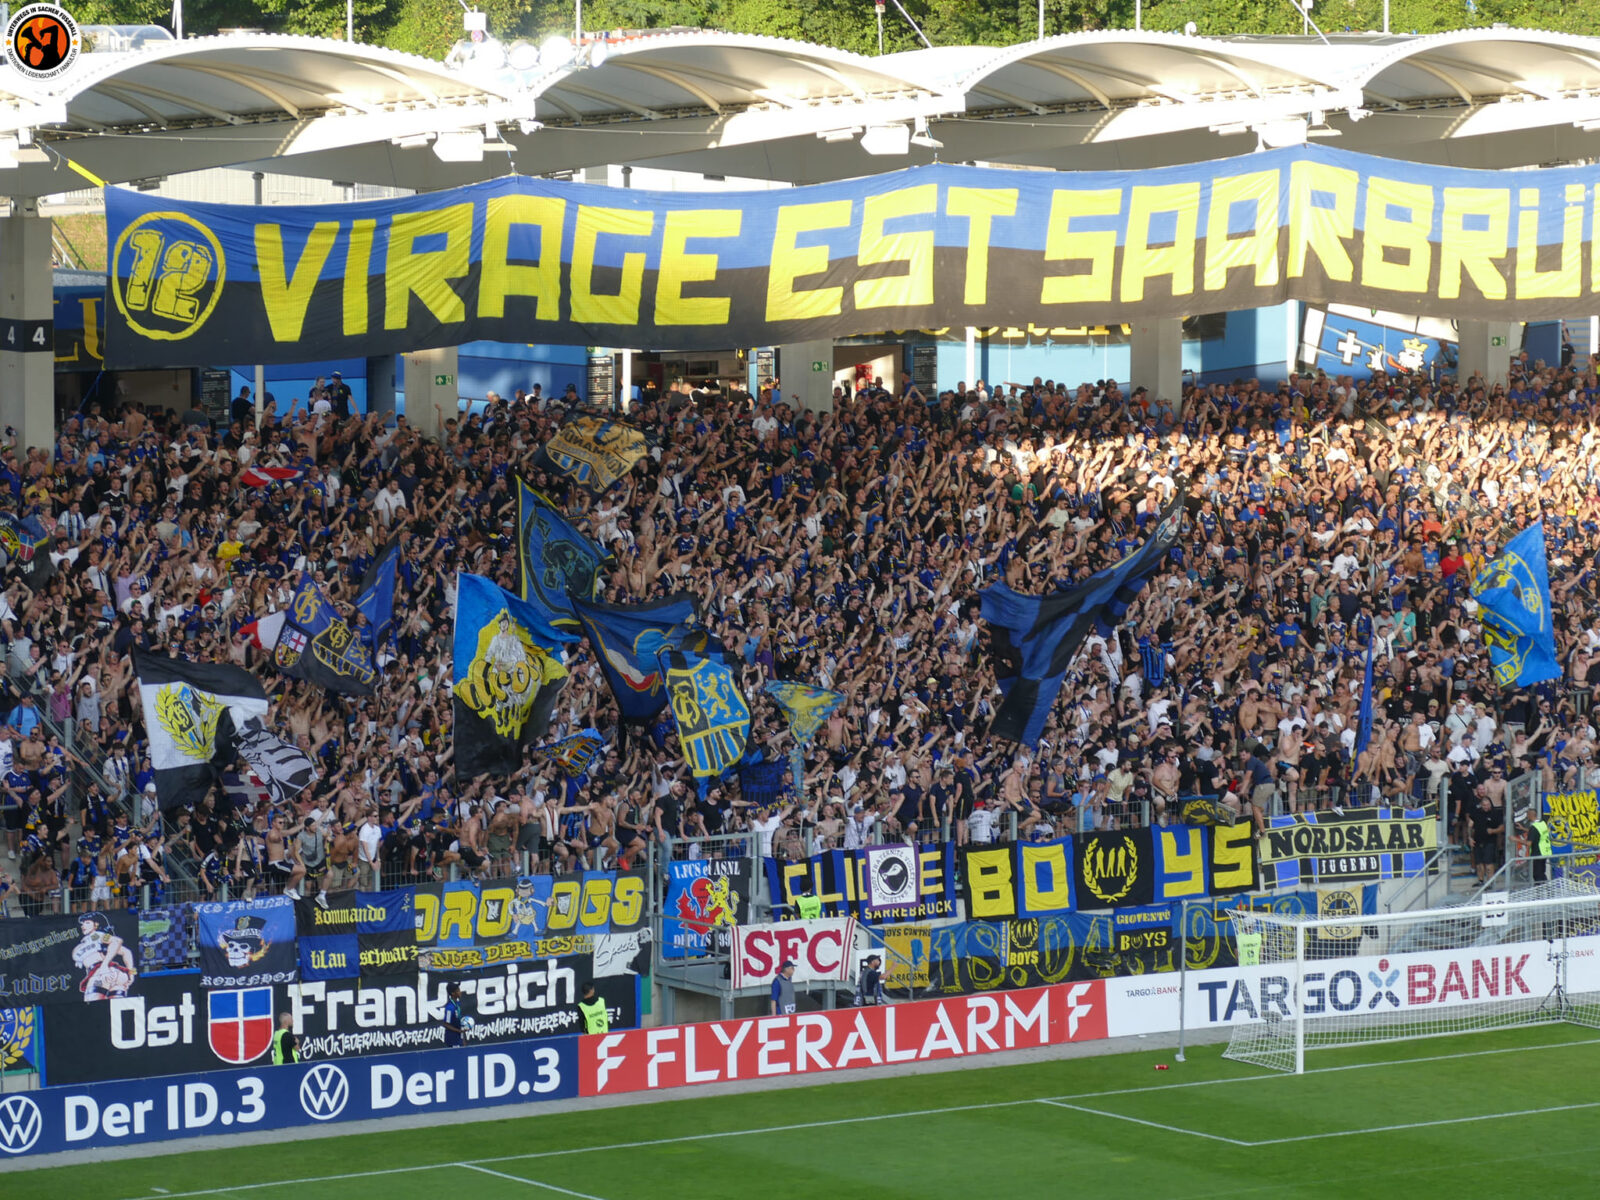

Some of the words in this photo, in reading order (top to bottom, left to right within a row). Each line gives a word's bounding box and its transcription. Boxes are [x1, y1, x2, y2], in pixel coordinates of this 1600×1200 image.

[254, 194, 742, 342] VIRAGE
[765, 184, 1019, 322] EST
[1041, 160, 1600, 303] SAARBRÜ
[8, 326, 15, 344] 4
[33, 327, 45, 345] 4
[1268, 824, 1424, 859] NORDSAAR
[714, 861, 741, 876] ASNL
[784, 851, 943, 906] CLIE
[1321, 856, 1378, 874] JUGEND
[432, 950, 484, 969] NUR
[485, 941, 532, 962] DER
[536, 935, 577, 956] FCS
[743, 927, 842, 978] SFC
[1010, 951, 1039, 966] BOYS
[110, 992, 195, 1049] Ost
[647, 988, 1049, 1088] FLYERALARM
[370, 1064, 454, 1110] Der
[468, 1047, 561, 1099] ID.3
[65, 1095, 153, 1141] Der
[168, 1077, 266, 1130] ID.3
